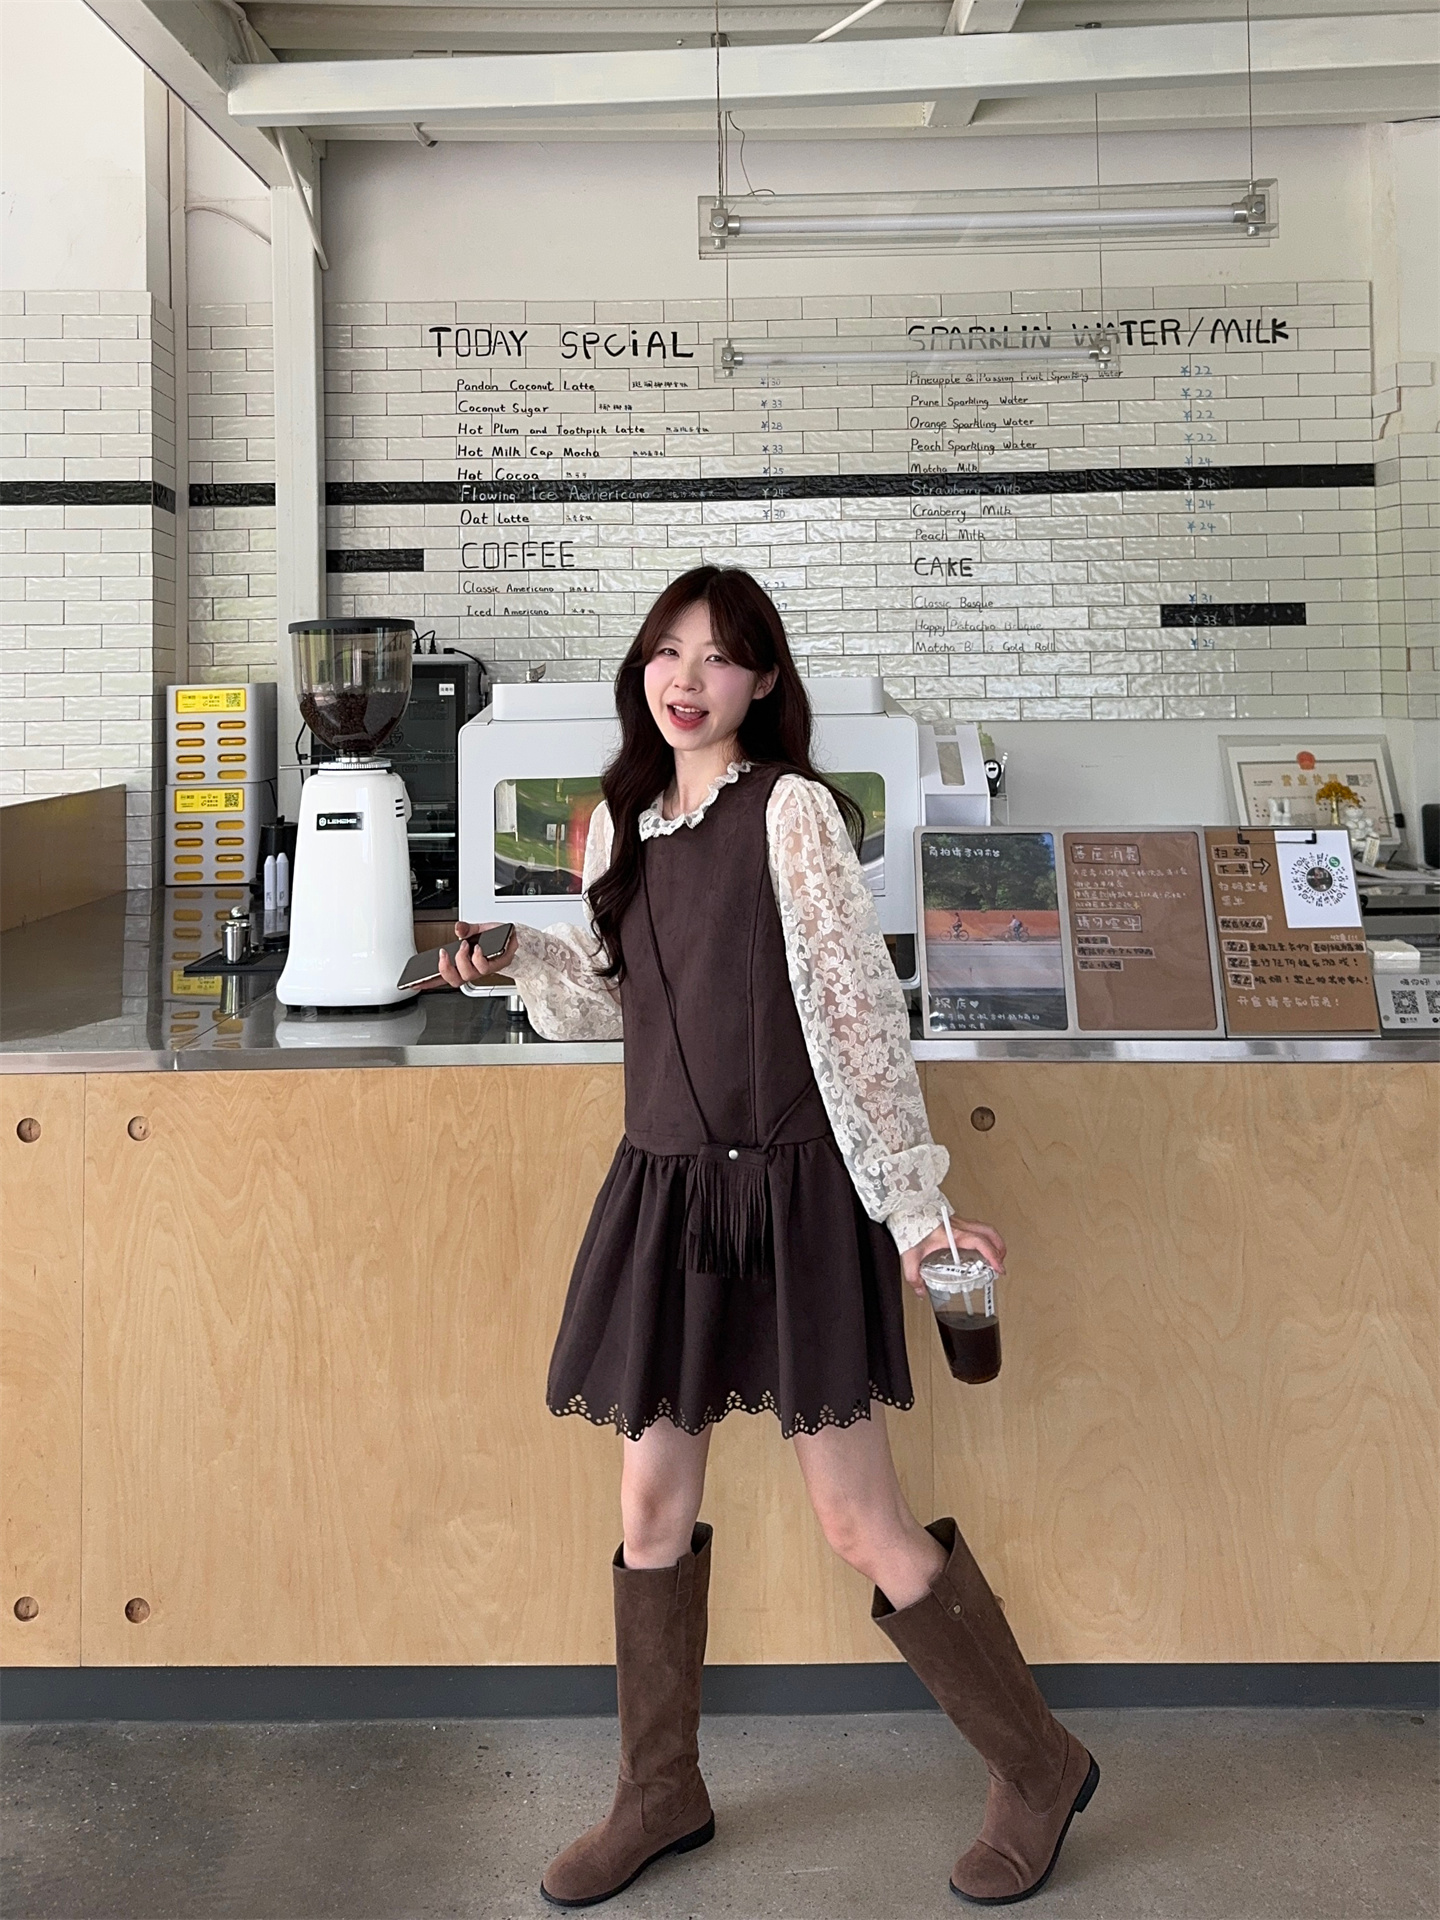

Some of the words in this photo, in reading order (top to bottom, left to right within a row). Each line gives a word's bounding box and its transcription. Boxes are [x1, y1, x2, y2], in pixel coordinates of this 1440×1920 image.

[428, 326, 528, 357] TODAY
[456, 379, 499, 391] Pandan
[509, 380, 555, 391] Coconut
[563, 381, 595, 391] Latte
[909, 370, 960, 386] Pineapple
[980, 372, 1014, 383] Passion
[458, 400, 507, 412] Coconut
[513, 402, 549, 417] Sugar
[910, 394, 940, 407] Prune
[947, 396, 989, 410] Sparkling
[999, 395, 1029, 405] Water
[458, 423, 484, 435] Hot
[494, 423, 519, 435] Plum
[529, 426, 548, 435] and
[557, 424, 607, 437] Toothpick
[910, 416, 947, 434] Orange
[952, 418, 997, 434] Sparkling
[1002, 417, 1034, 426] Water
[457, 444, 484, 457] Hot
[491, 445, 521, 457] Milk
[530, 446, 553, 459] Cap
[563, 446, 600, 458] Mocha
[911, 438, 941, 451] Peach
[947, 440, 995, 457] Sparkling
[457, 468, 483, 481] Hot
[495, 468, 540, 481] Cocoa
[910, 463, 948, 473] Matcha
[956, 462, 979, 473] Milk
[461, 485, 516, 503] Flowing
[531, 485, 557, 501] Ice
[911, 479, 981, 495] Strawberry
[994, 484, 1021, 495] Milk
[460, 509, 489, 525] Oat
[912, 503, 966, 523] Cranberry
[982, 505, 1013, 516] Milk
[915, 528, 947, 541] Peach
[958, 529, 986, 541] Milk
[461, 541, 575, 569] COFFEE
[914, 556, 974, 578] CAKE
[462, 581, 499, 593] Classic
[506, 583, 555, 593] Americano
[466, 605, 492, 617] Iced
[503, 607, 550, 616] Americano
[914, 595, 951, 609] Classic
[960, 597, 994, 613] Basque
[915, 619, 946, 637] Happy
[915, 642, 956, 652] Matcha
[1214, 847, 1249, 858] 扫码
[1219, 864, 1249, 875] 下单
